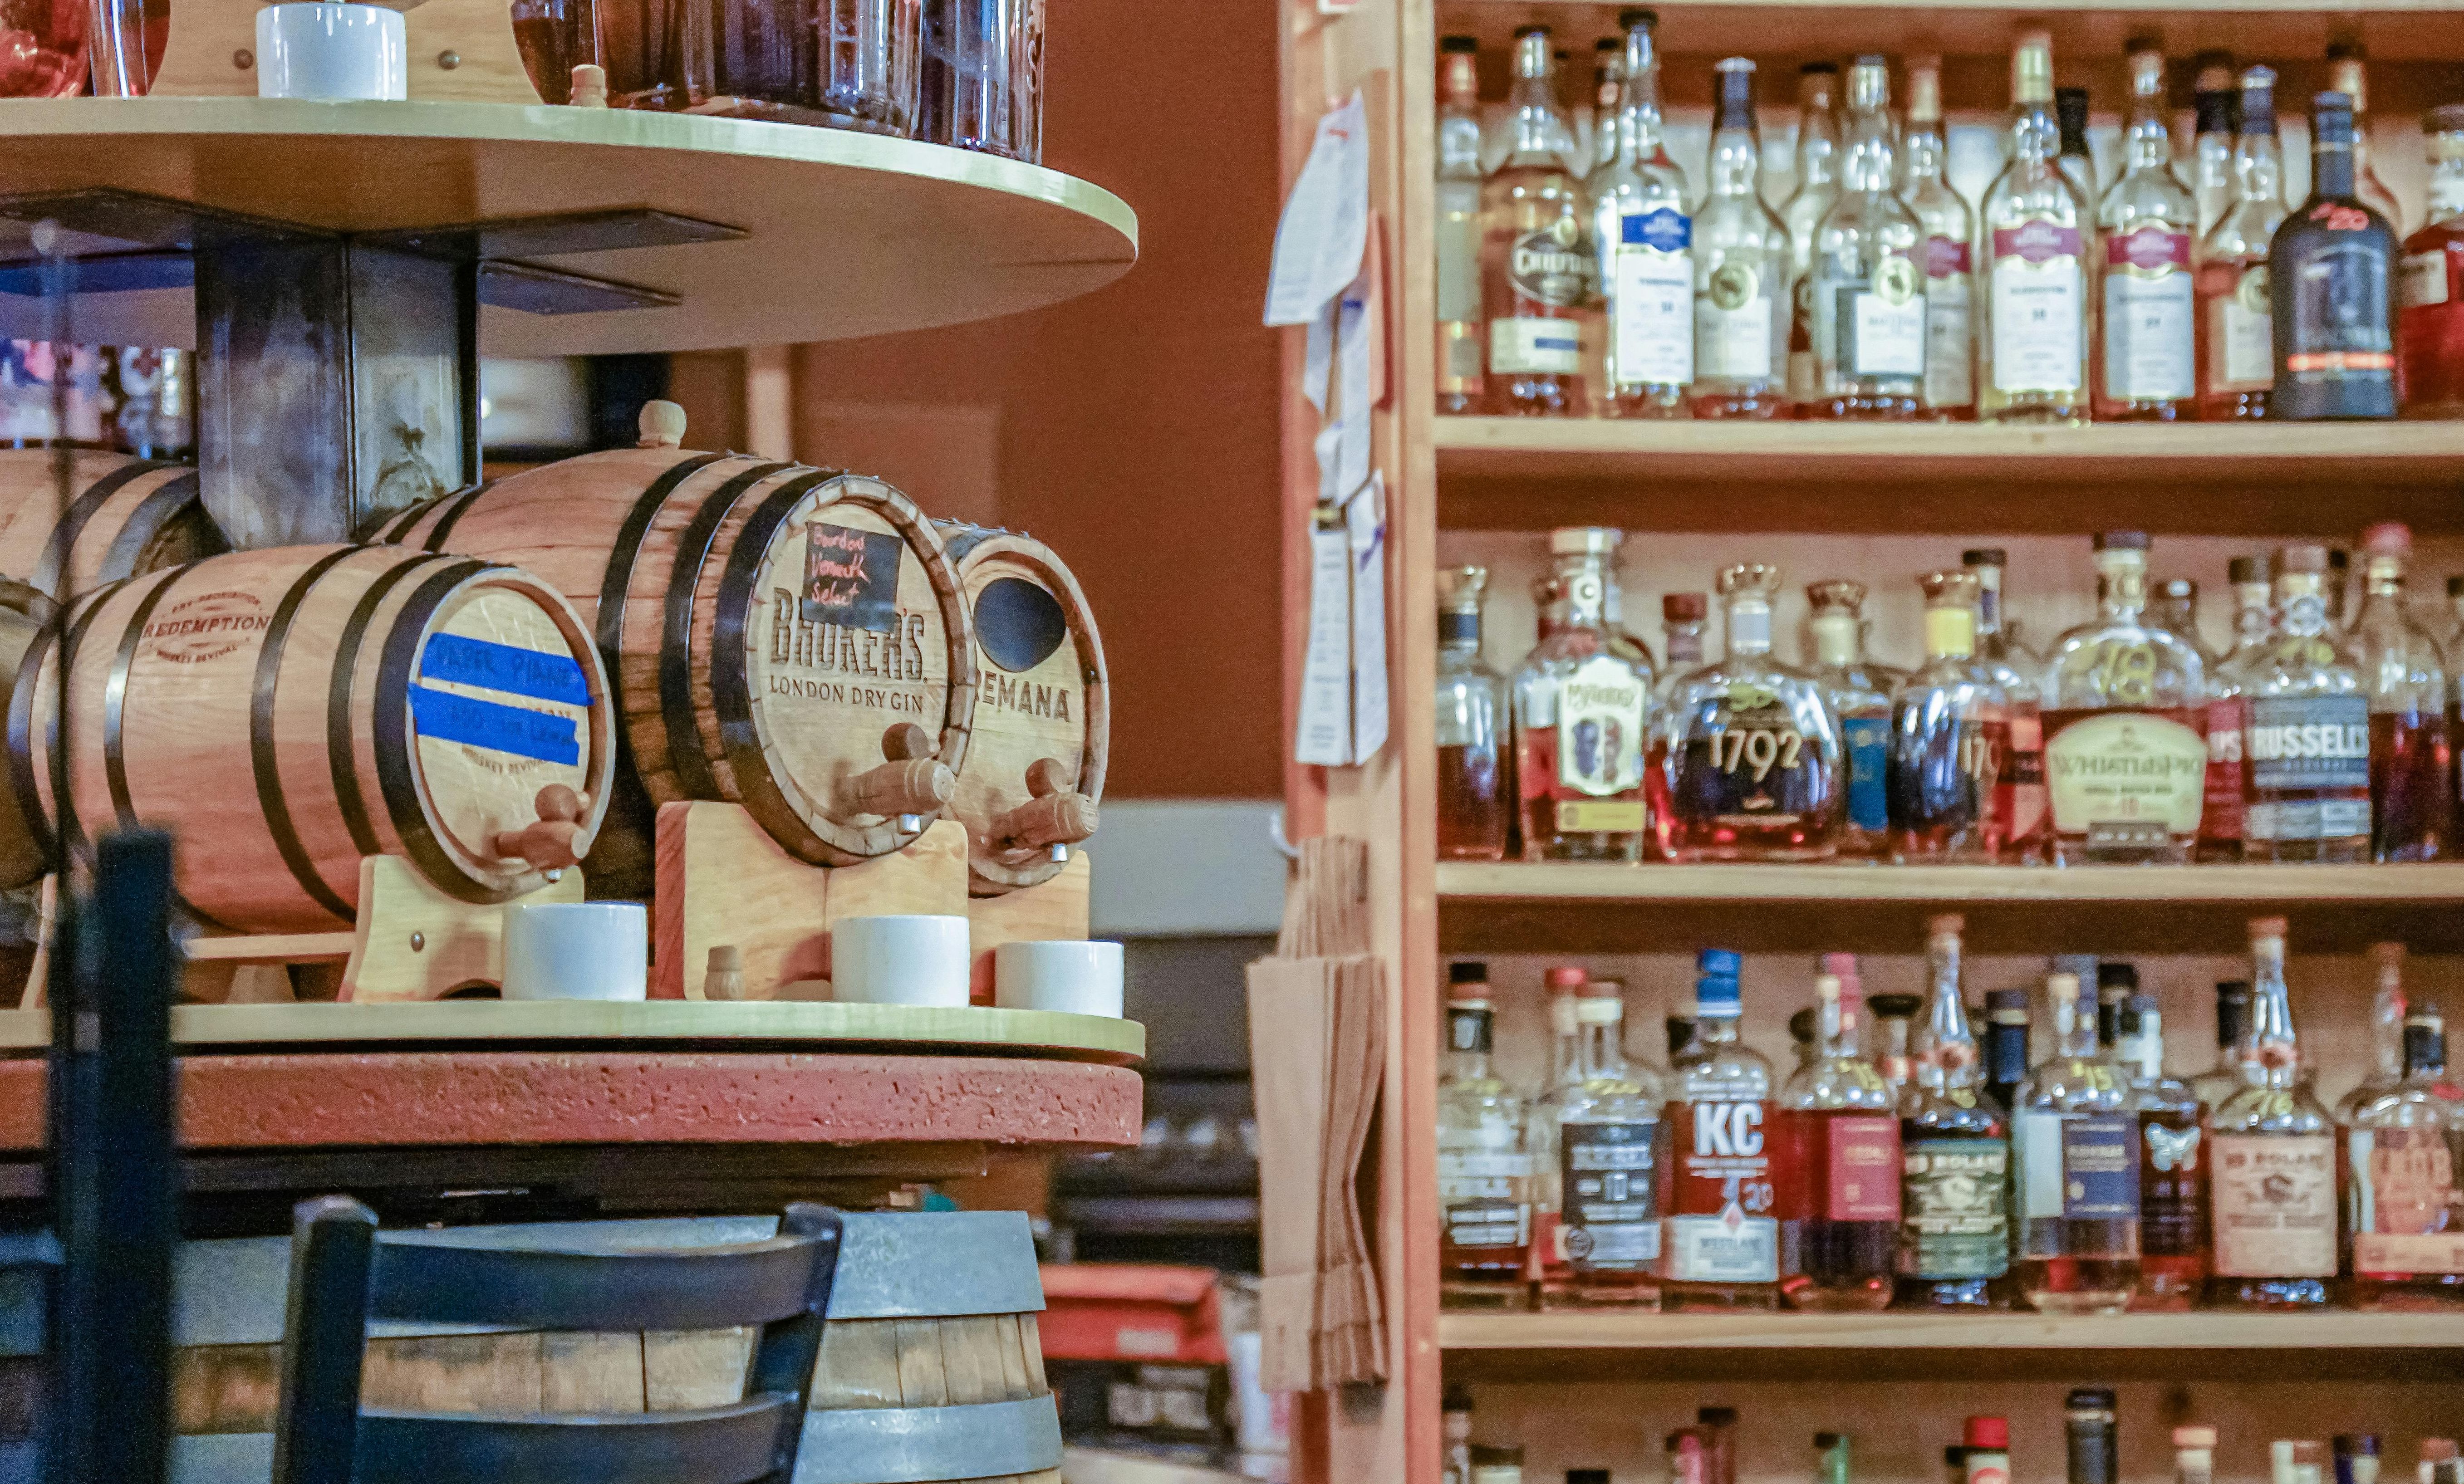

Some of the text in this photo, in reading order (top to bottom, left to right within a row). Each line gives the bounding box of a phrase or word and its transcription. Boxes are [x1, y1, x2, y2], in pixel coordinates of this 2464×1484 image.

[142, 615, 272, 638] REDEMPTION
[770, 675, 923, 714] LONDON DRY GIN
[1710, 729, 1803, 783] 1792
[1696, 1102, 1763, 1156] KC
